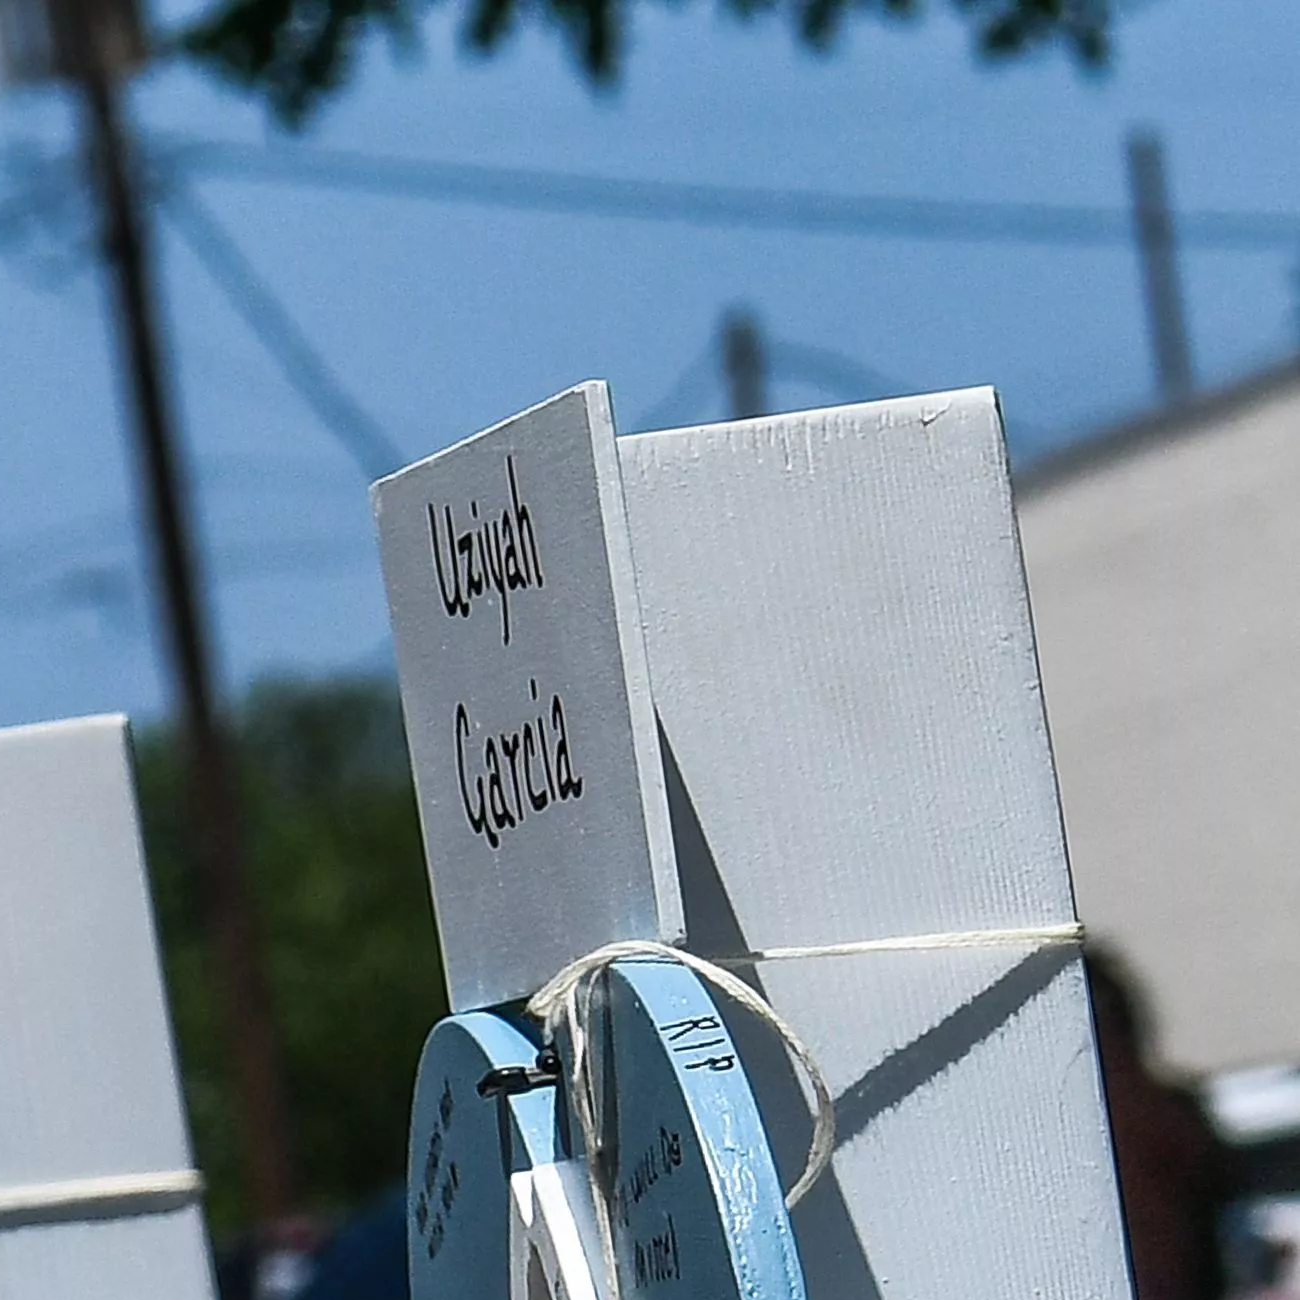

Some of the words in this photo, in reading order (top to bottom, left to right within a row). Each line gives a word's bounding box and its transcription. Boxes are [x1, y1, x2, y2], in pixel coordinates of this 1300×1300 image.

[427, 454, 544, 646] Uziyah
[455, 677, 583, 849] Garcia
[659, 1015, 739, 1072] RIP
